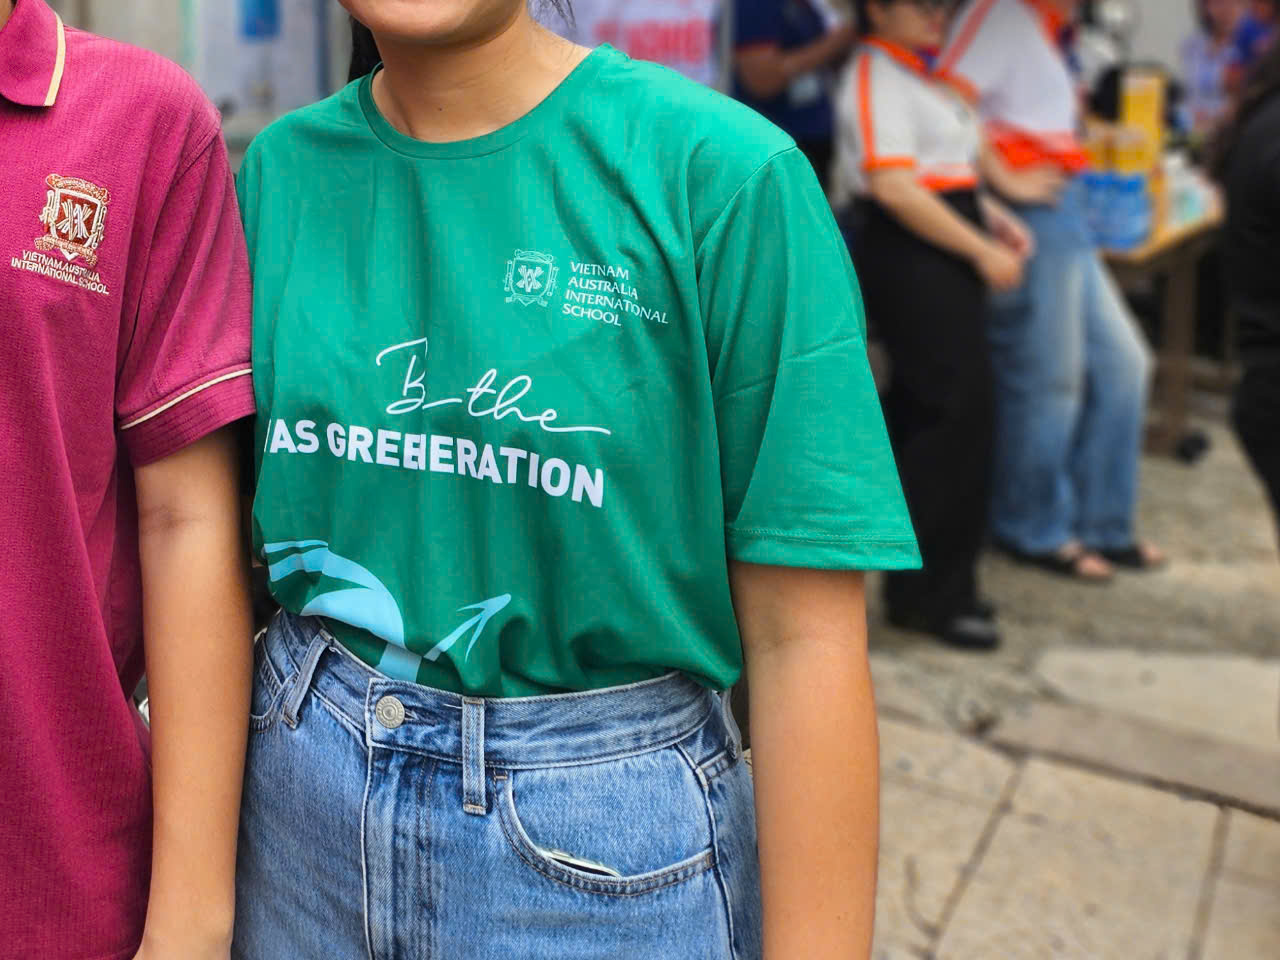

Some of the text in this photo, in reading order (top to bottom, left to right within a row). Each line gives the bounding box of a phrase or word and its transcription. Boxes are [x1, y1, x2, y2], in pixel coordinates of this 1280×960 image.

[22, 249, 63, 271] VIETNAM
[570, 261, 629, 281] VIETNAM
[11, 257, 110, 296] INTERNATIONAL SCHOOL
[568, 276, 639, 301] AUSTRALIA
[562, 303, 622, 327] SCHOOL
[466, 368, 612, 435] the
[264, 419, 320, 454] AS
